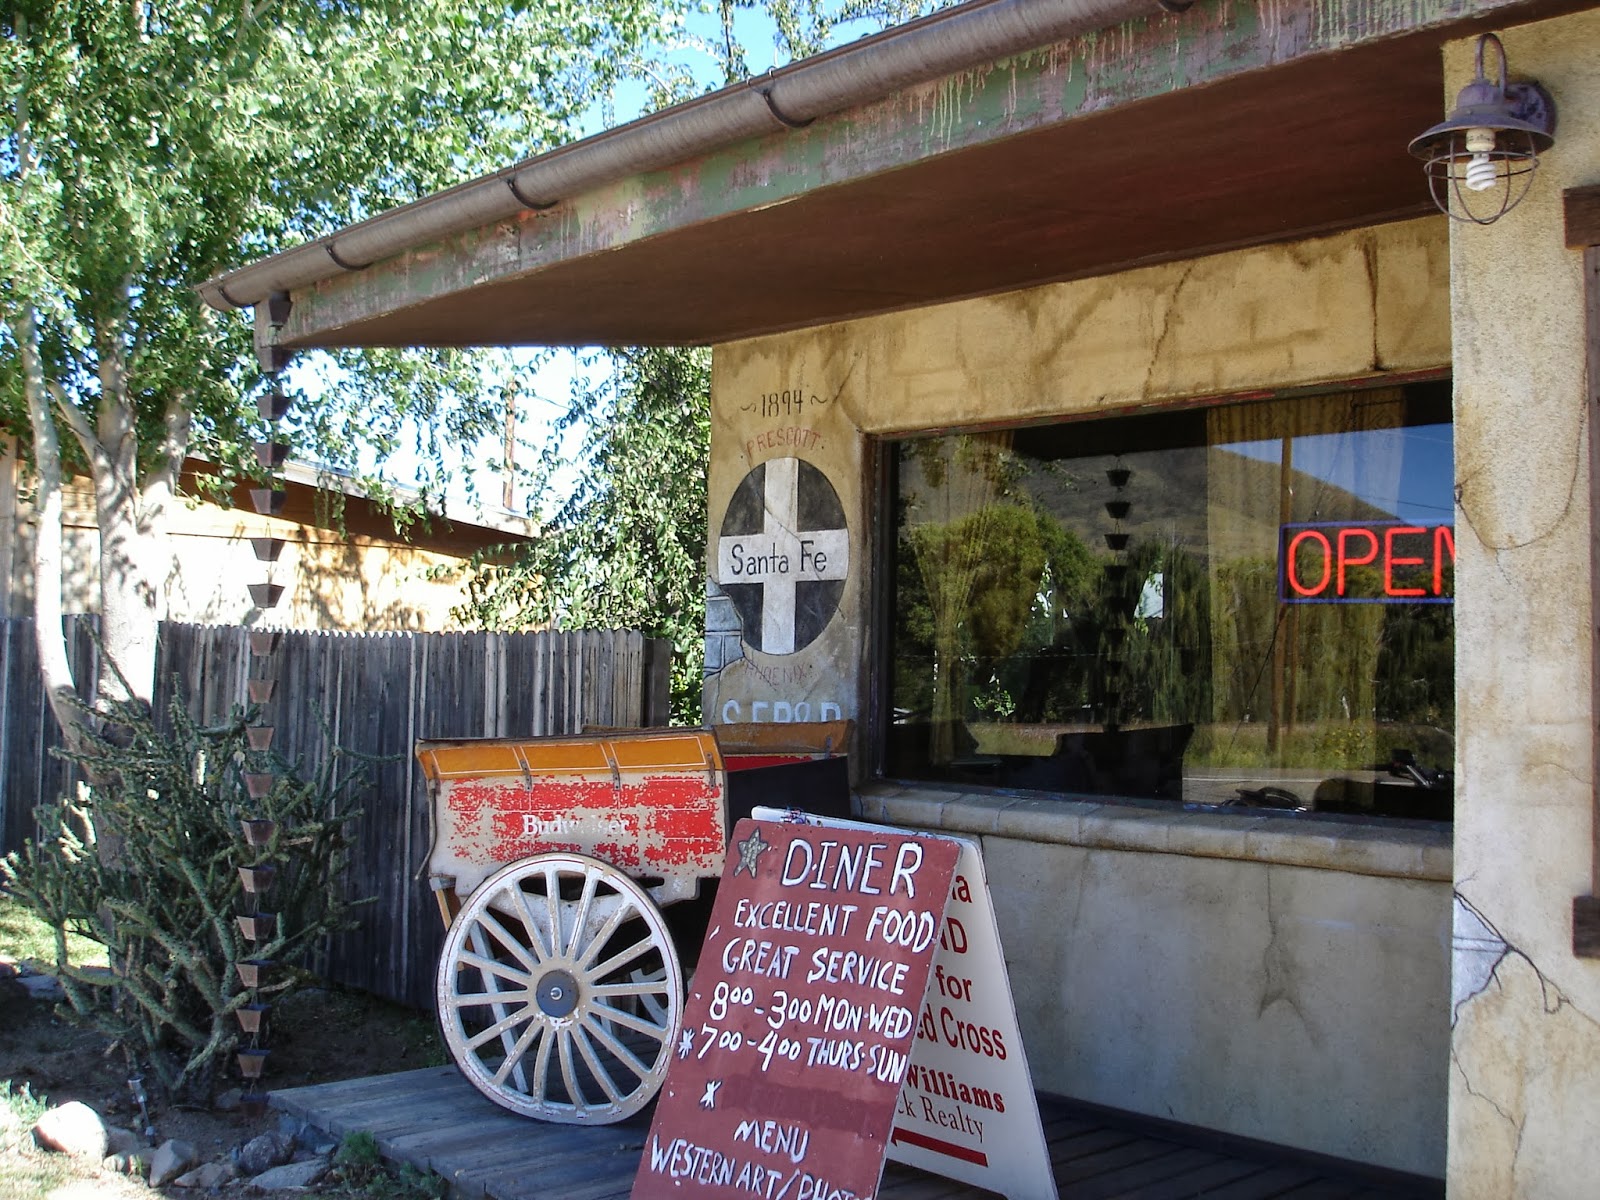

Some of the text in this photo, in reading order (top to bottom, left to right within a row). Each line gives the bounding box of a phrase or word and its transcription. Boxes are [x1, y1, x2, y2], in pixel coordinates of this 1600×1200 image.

[762, 389, 804, 418] 1894
[731, 540, 828, 576] Santa Fe
[781, 838, 923, 899] DINER
[734, 898, 858, 937] EXCELLENT
[866, 905, 935, 954] FOOD
[722, 937, 910, 995] GREAT SERVICE
[935, 965, 972, 1002] for
[940, 1006, 1007, 1061] Cross
[733, 1119, 810, 1164] MENU
[920, 1095, 984, 1144] Realty
[651, 1134, 736, 1186] WESTERN
